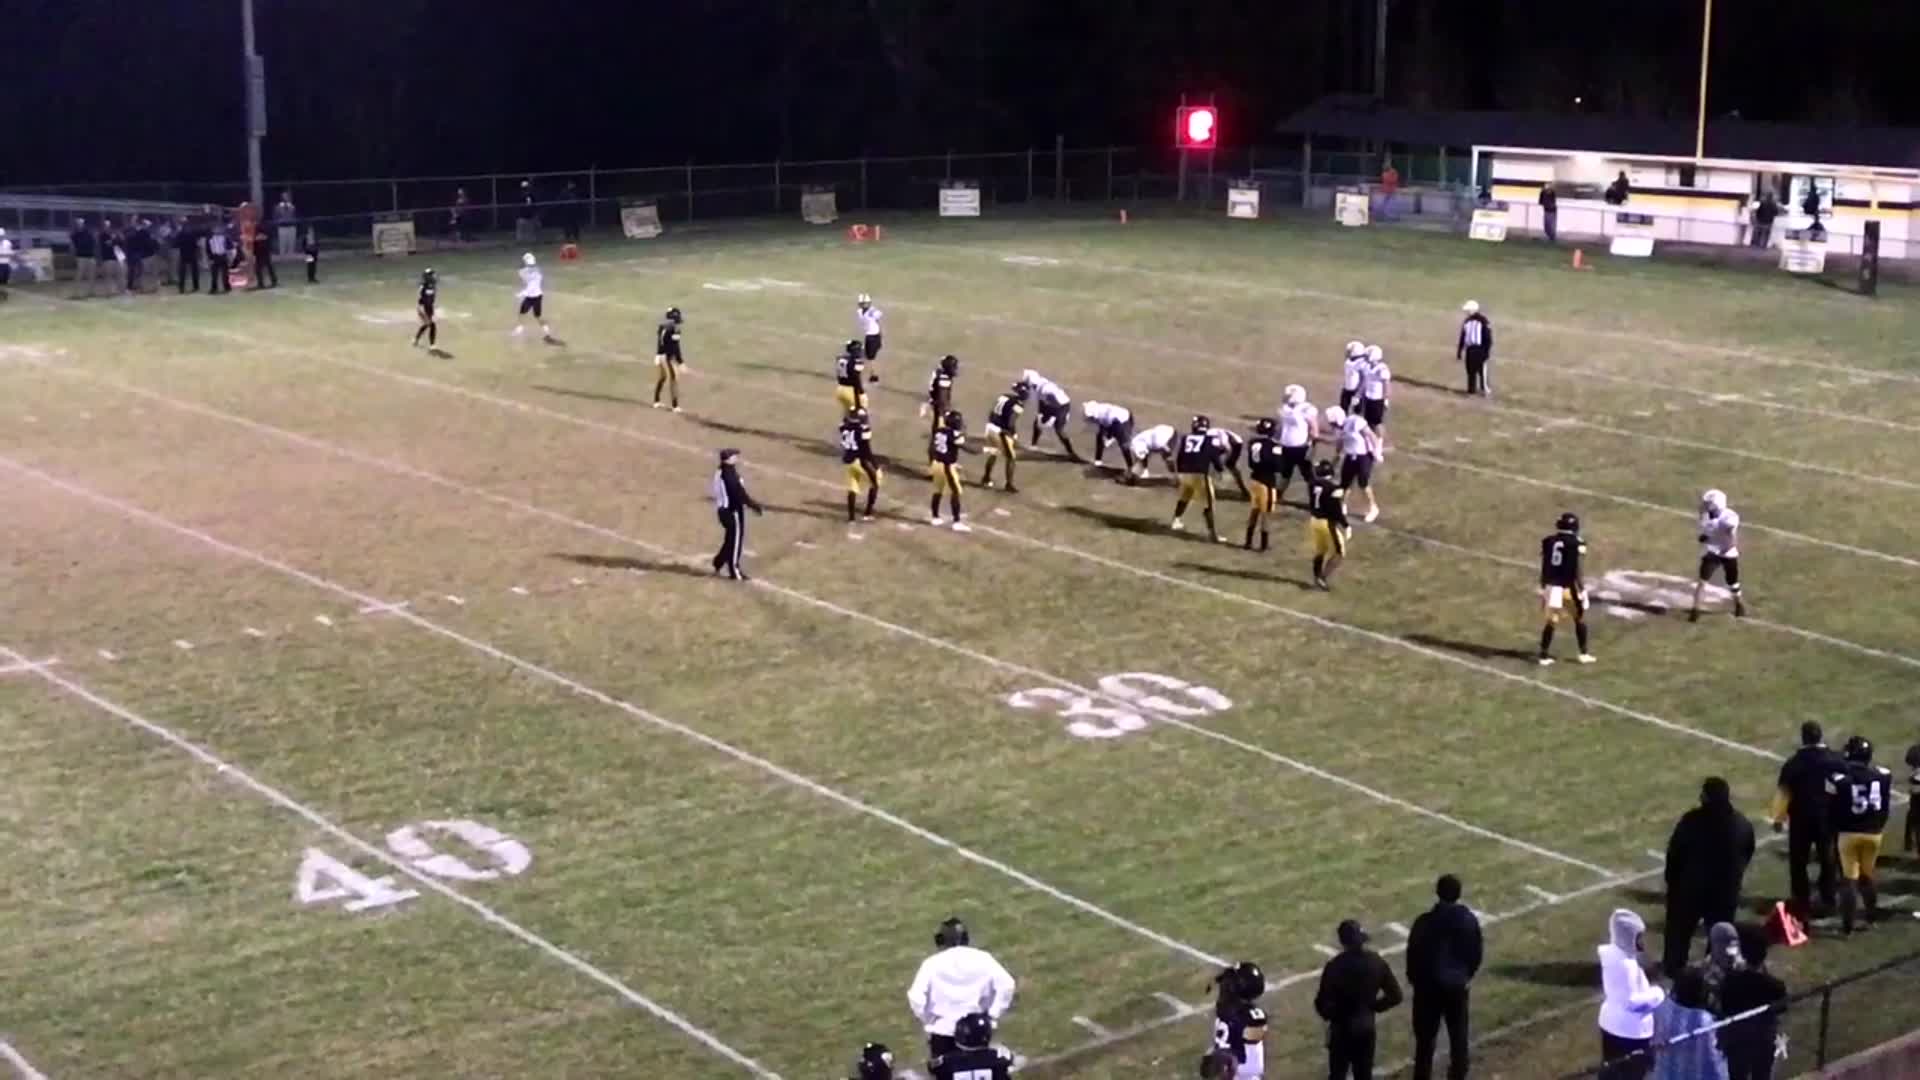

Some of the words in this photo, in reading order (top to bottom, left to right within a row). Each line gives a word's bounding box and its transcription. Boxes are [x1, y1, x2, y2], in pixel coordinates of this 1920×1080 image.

[1184, 434, 1205, 453] 57
[1313, 486, 1323, 509] 7
[1551, 541, 1565, 566] 6
[1010, 673, 1232, 738] 30
[1851, 780, 1882, 815] 54
[295, 819, 531, 911] 40
